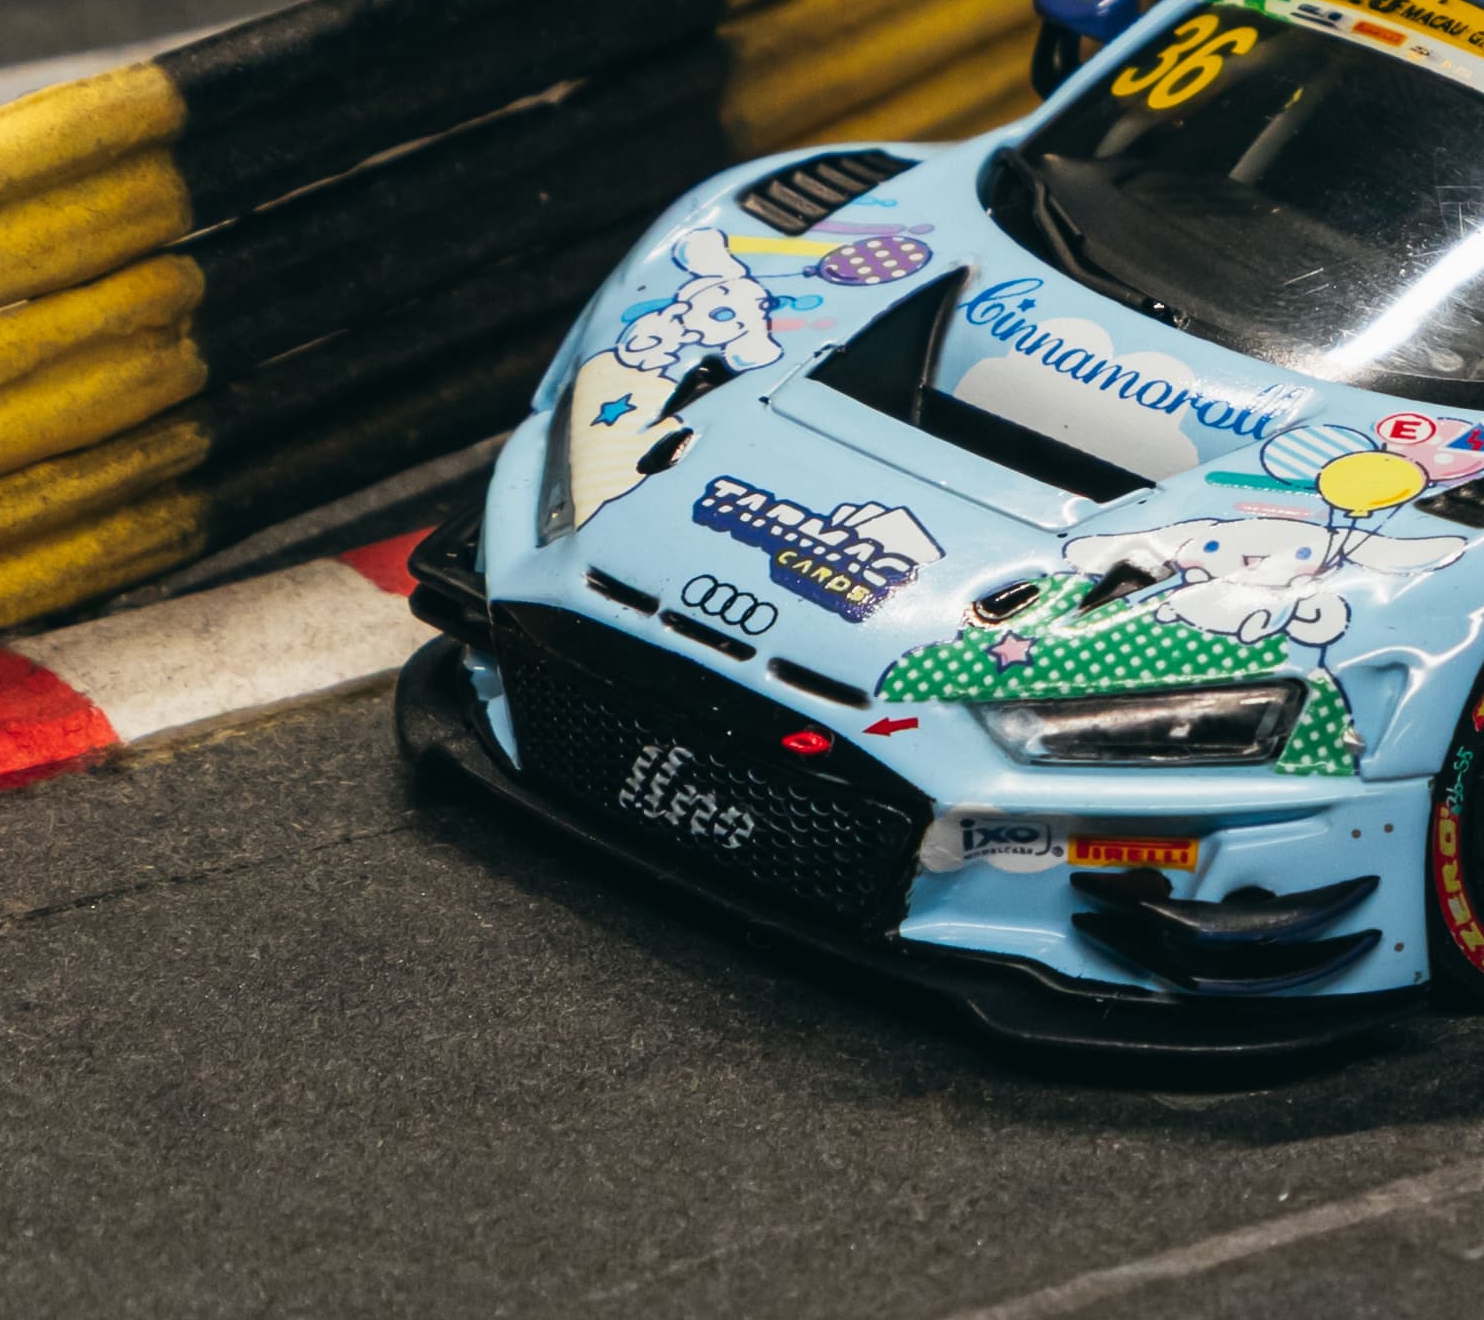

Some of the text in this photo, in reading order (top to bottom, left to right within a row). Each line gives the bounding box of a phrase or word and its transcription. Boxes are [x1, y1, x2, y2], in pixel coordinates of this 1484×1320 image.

[1401, 3, 1470, 37] MACAU
[1111, 13, 1260, 111] 36
[954, 277, 1313, 440] Cinnamoroll
[701, 479, 911, 587] TARMAC
[777, 550, 874, 603] CARDS
[1075, 838, 1191, 864] PIRELLI
